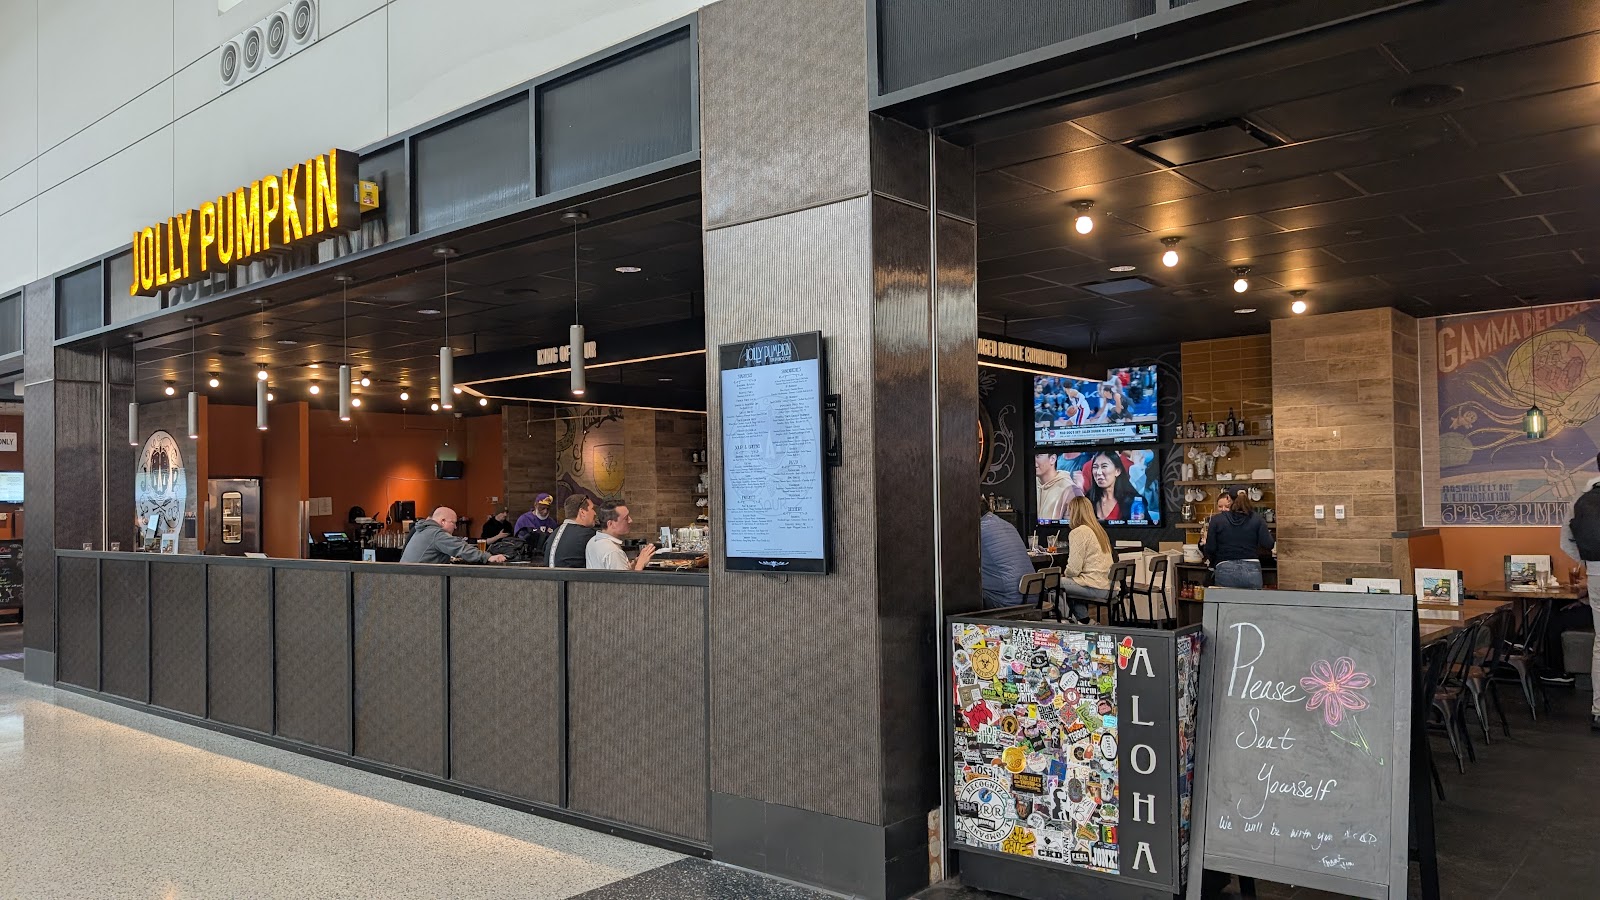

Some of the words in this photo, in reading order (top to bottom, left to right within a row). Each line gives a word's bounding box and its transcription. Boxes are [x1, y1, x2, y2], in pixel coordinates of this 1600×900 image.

[130, 209, 193, 296] JOLLY
[200, 148, 338, 272] PUMPKIN
[537, 347, 558, 365] KING
[559, 345, 571, 362] OF
[745, 346, 763, 362] JOLLY
[764, 343, 792, 361] PUMPKIN
[998, 341, 1025, 362] BOTTLE
[1437, 314, 1521, 373] GAMMA
[1228, 622, 1306, 702] Please
[1235, 706, 1296, 750] Seat
[1130, 648, 1158, 873] ALOHA
[966, 781, 1006, 796] RECOGNIZ
[1237, 762, 1337, 820] Yourself
[1219, 815, 1233, 830] We
[1244, 821, 1263, 833] will
[1270, 822, 1280, 836] be
[1290, 830, 1312, 840] with
[1311, 832, 1334, 850] you
